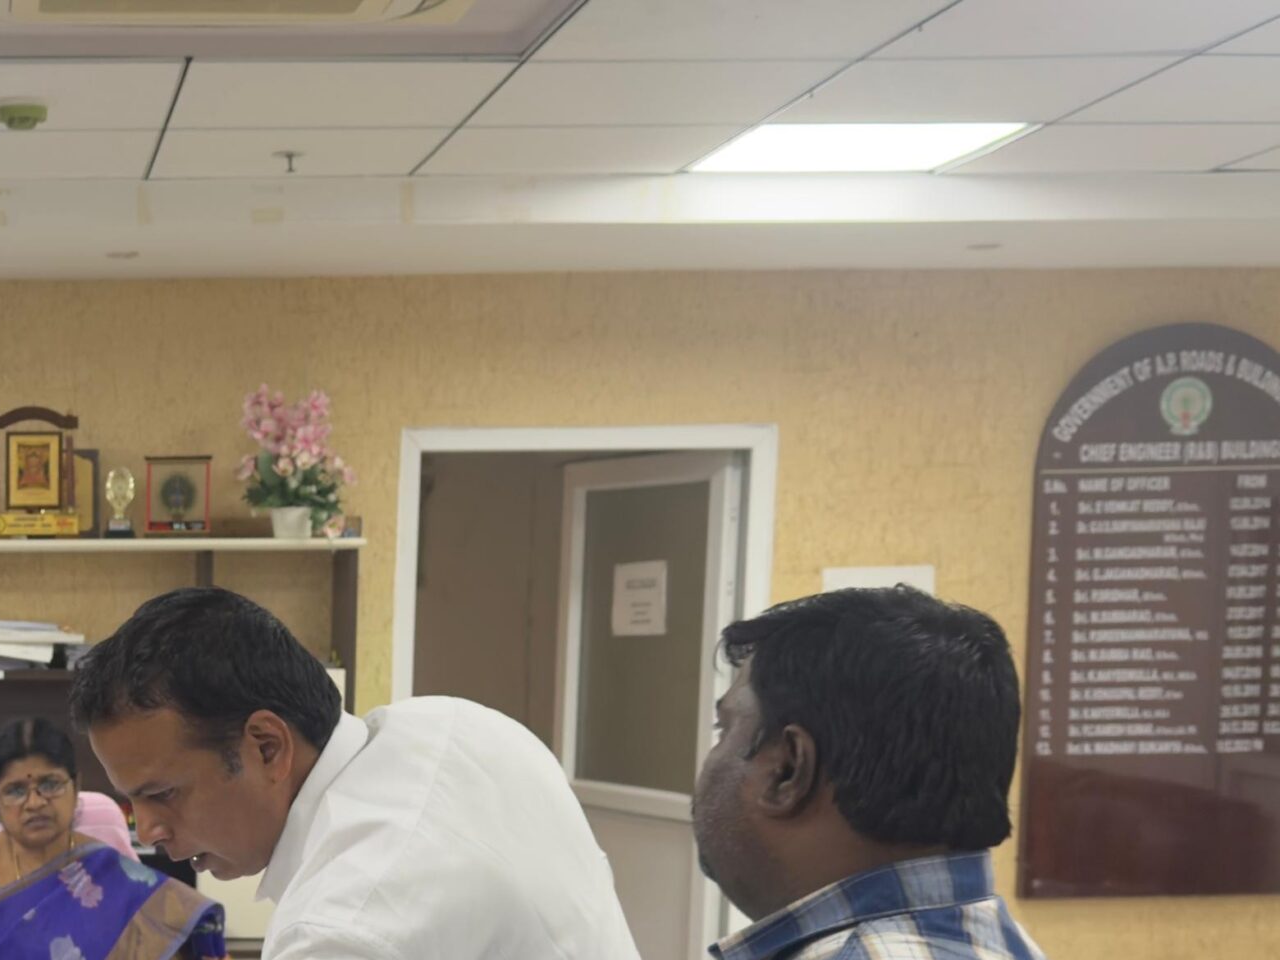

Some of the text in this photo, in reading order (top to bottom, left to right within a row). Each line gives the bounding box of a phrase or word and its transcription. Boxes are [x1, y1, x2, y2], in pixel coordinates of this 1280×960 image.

[1052, 366, 1134, 443] GOVERNMENT
[1132, 357, 1152, 382] OF
[1179, 350, 1224, 374] ROADS
[1079, 443, 1117, 463] CHIEF
[1119, 442, 1181, 461] ENGINEER
[1183, 441, 1219, 464] (R&B)
[1078, 478, 1107, 493] NAME
[1127, 476, 1171, 491] OFFICER
[1236, 474, 1268, 489] FROM
